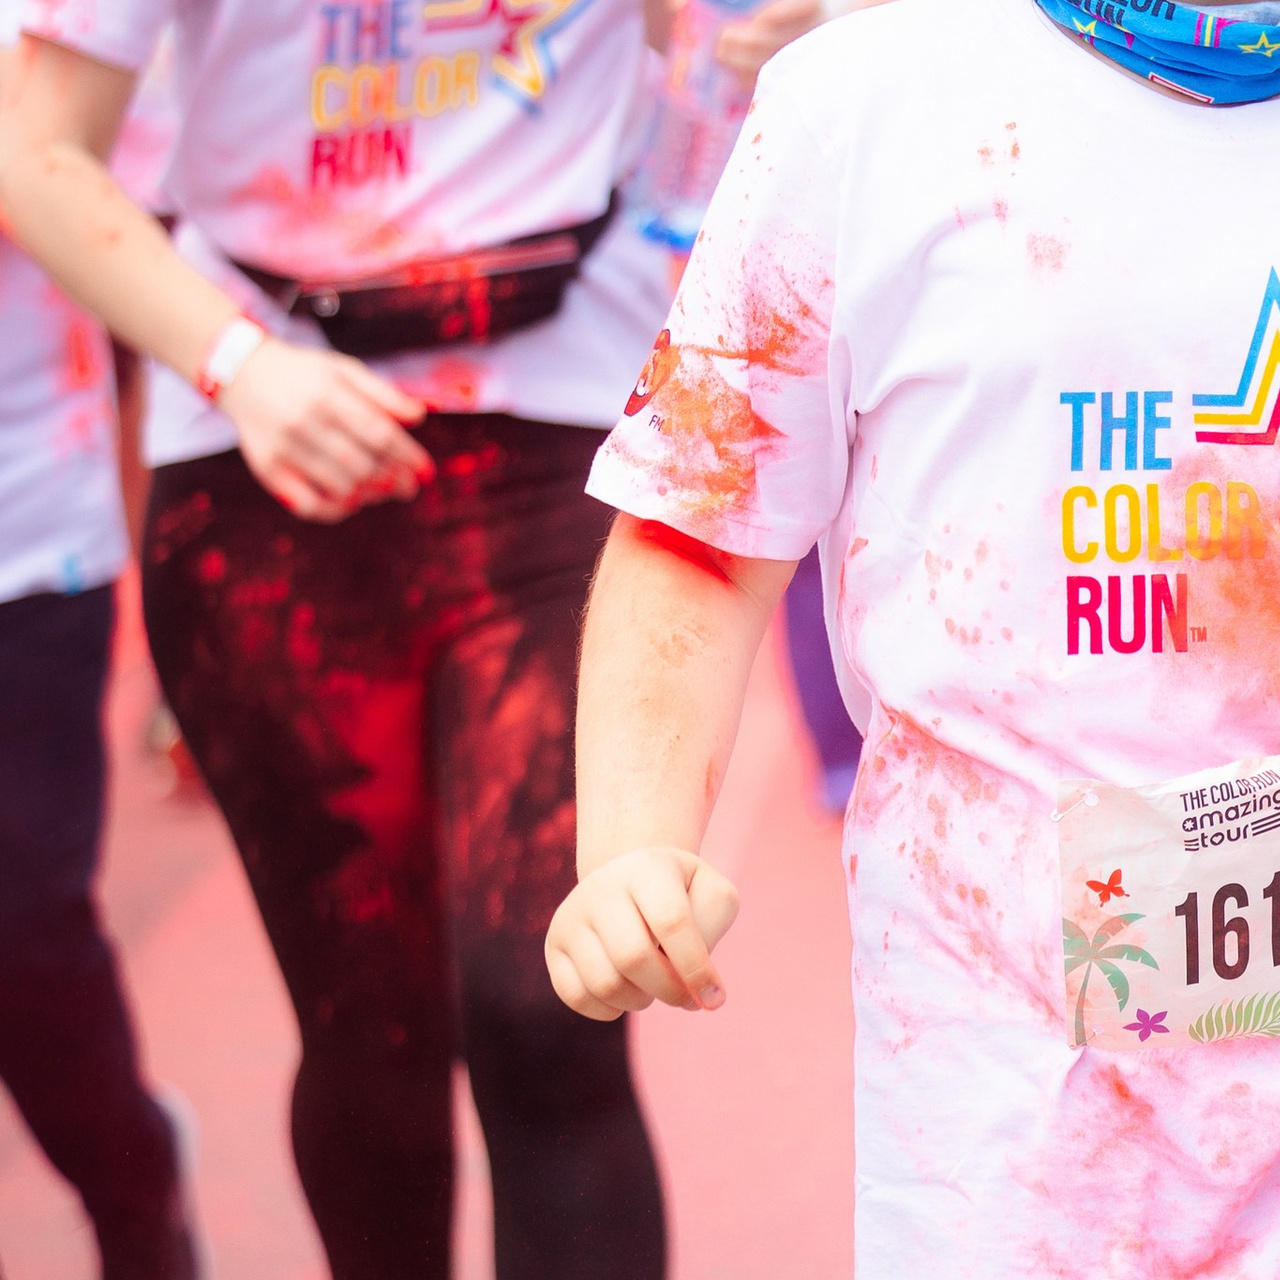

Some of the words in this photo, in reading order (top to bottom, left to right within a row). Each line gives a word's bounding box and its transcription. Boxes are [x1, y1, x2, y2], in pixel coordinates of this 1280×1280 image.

[311, 49, 480, 133] COLOR
[310, 126, 415, 188] RUN
[1060, 391, 1173, 471] THE
[1061, 480, 1267, 564] COLOR
[1066, 573, 1188, 656] RUN
[1180, 788, 1209, 812] THE
[1210, 777, 1257, 805] COLOR
[1200, 823, 1249, 848] tour
